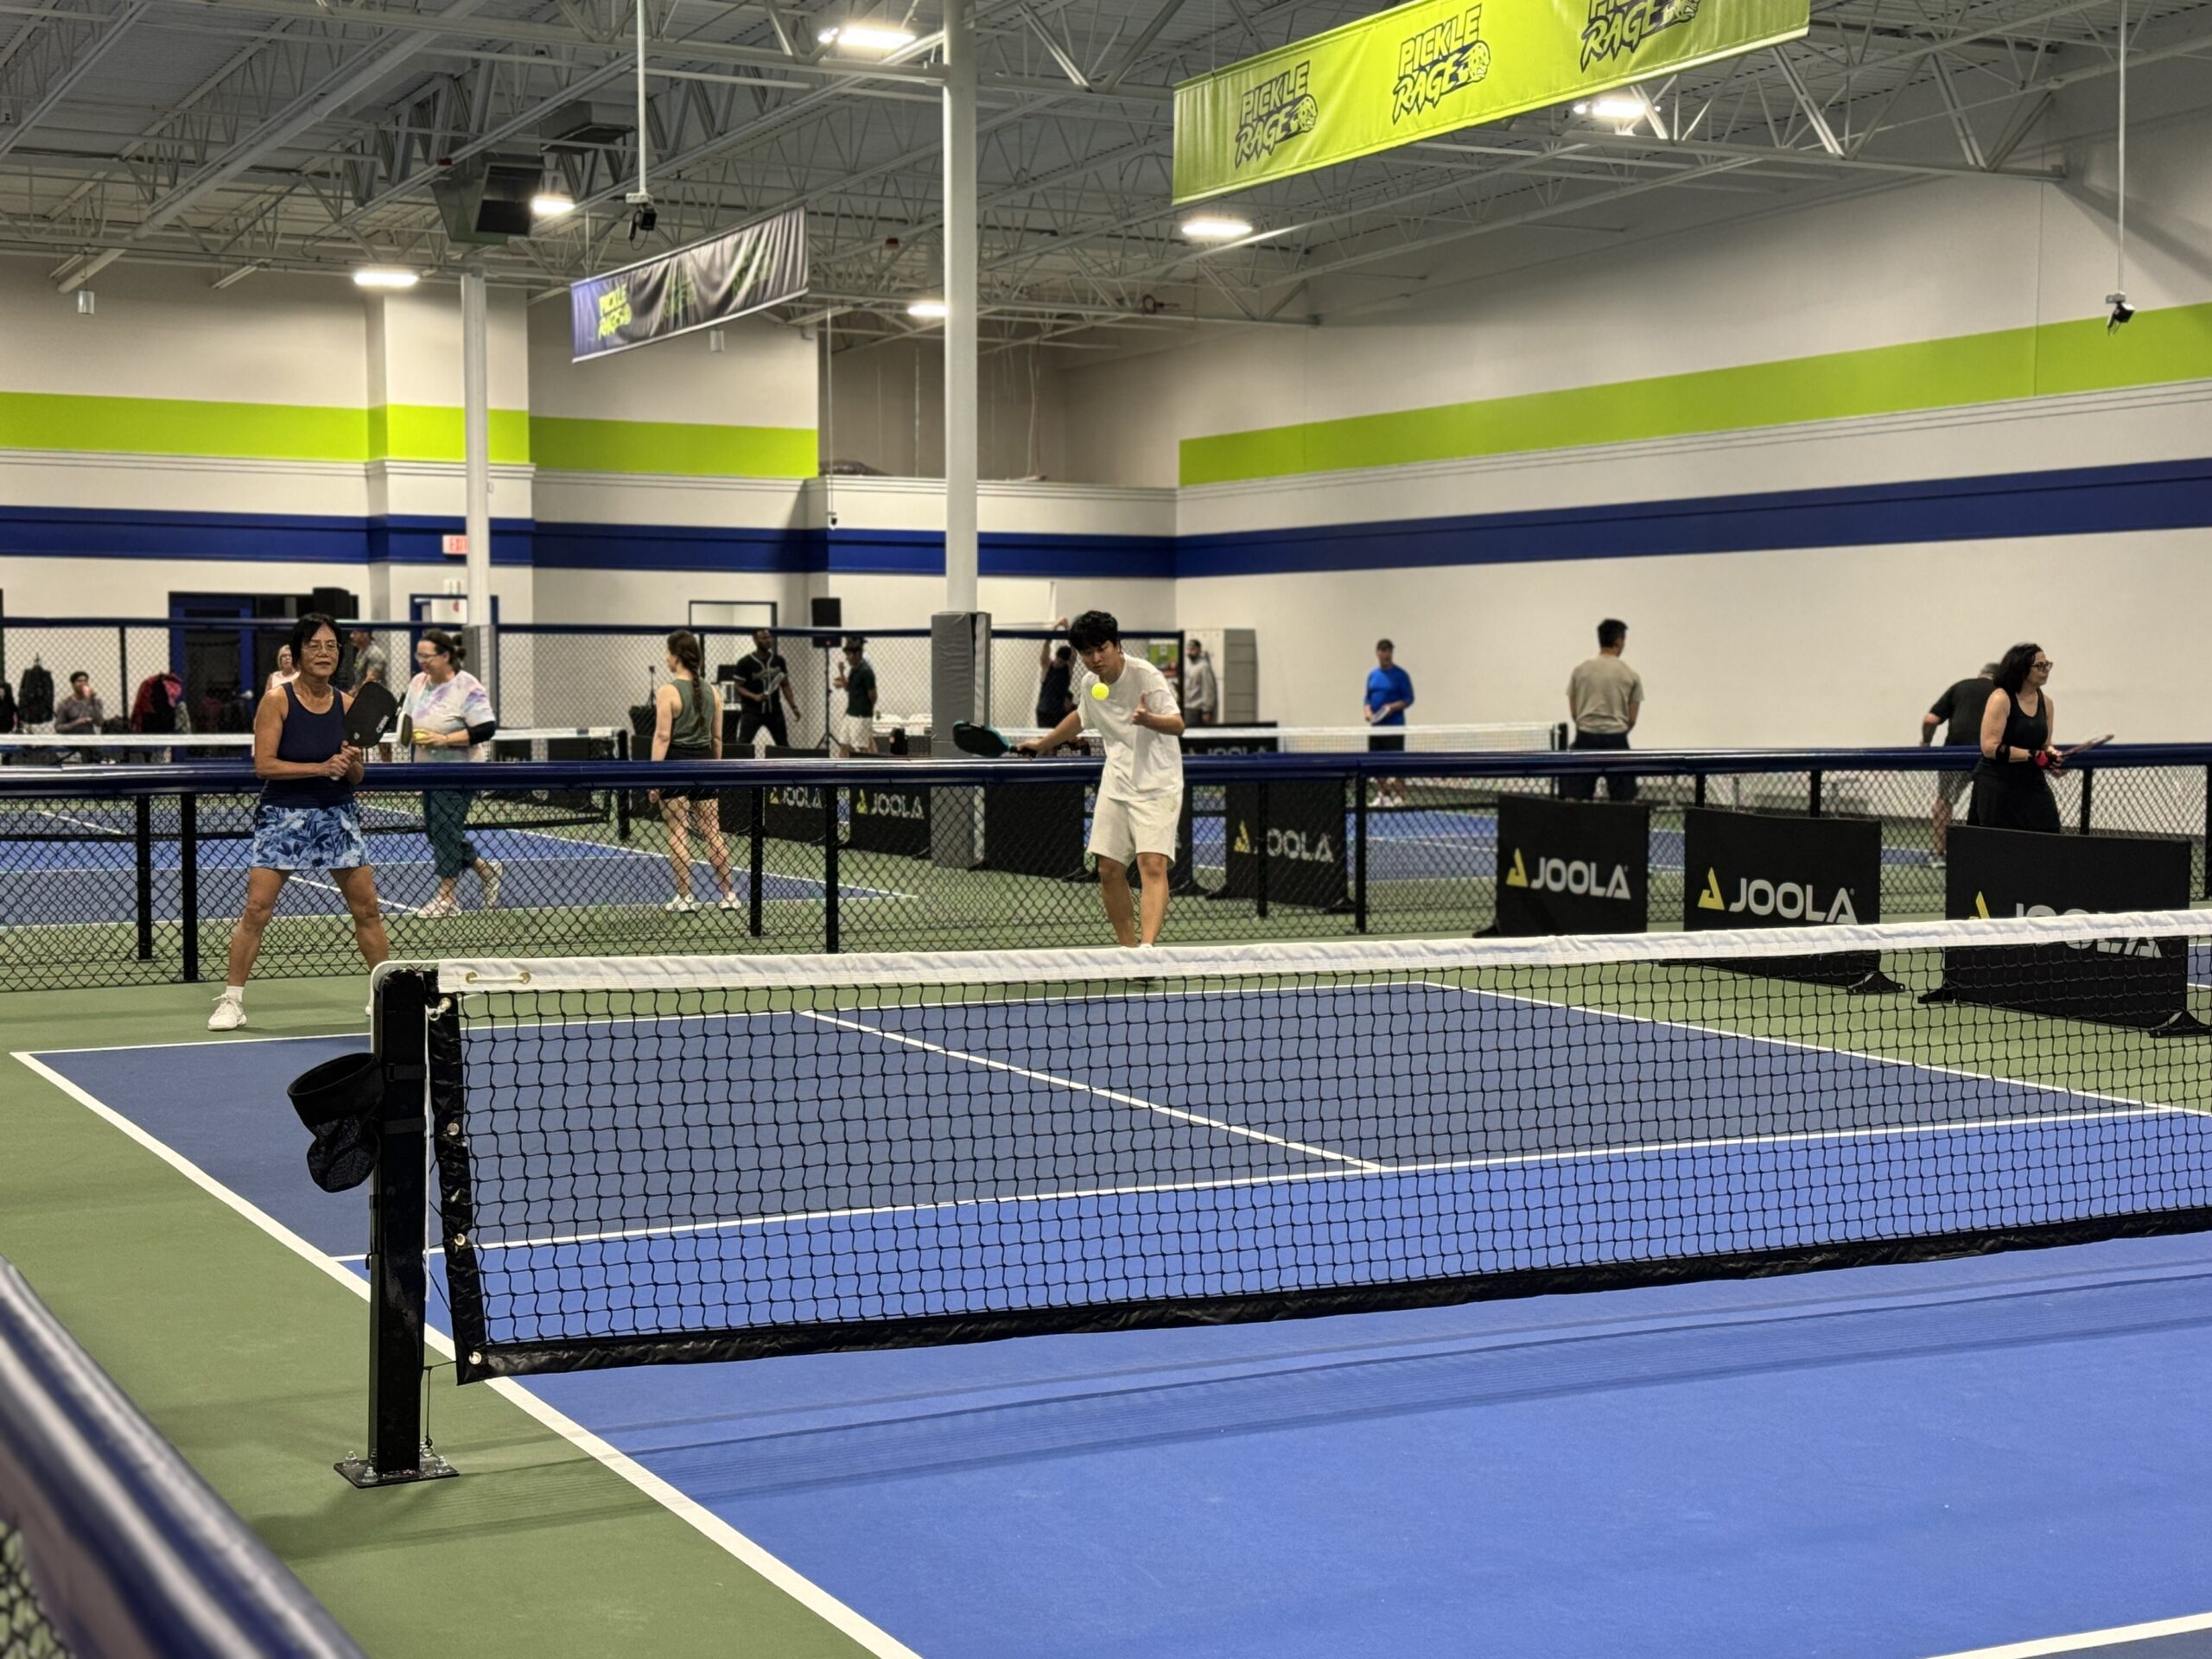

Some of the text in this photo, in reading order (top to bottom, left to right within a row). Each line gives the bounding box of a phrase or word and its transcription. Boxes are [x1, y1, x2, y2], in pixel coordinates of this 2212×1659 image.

[1397, 3, 1482, 80] PICKLE
[1580, 0, 1661, 73] RAGE
[1239, 60, 1310, 128] PICKLE
[1392, 52, 1463, 126] RAGE
[1235, 105, 1294, 170] RAGE
[870, 792, 925, 819] JOOLA
[1254, 828, 1335, 862] OOLA
[1530, 856, 1631, 900] JOOLA
[1729, 877, 1858, 925] JOOLA
